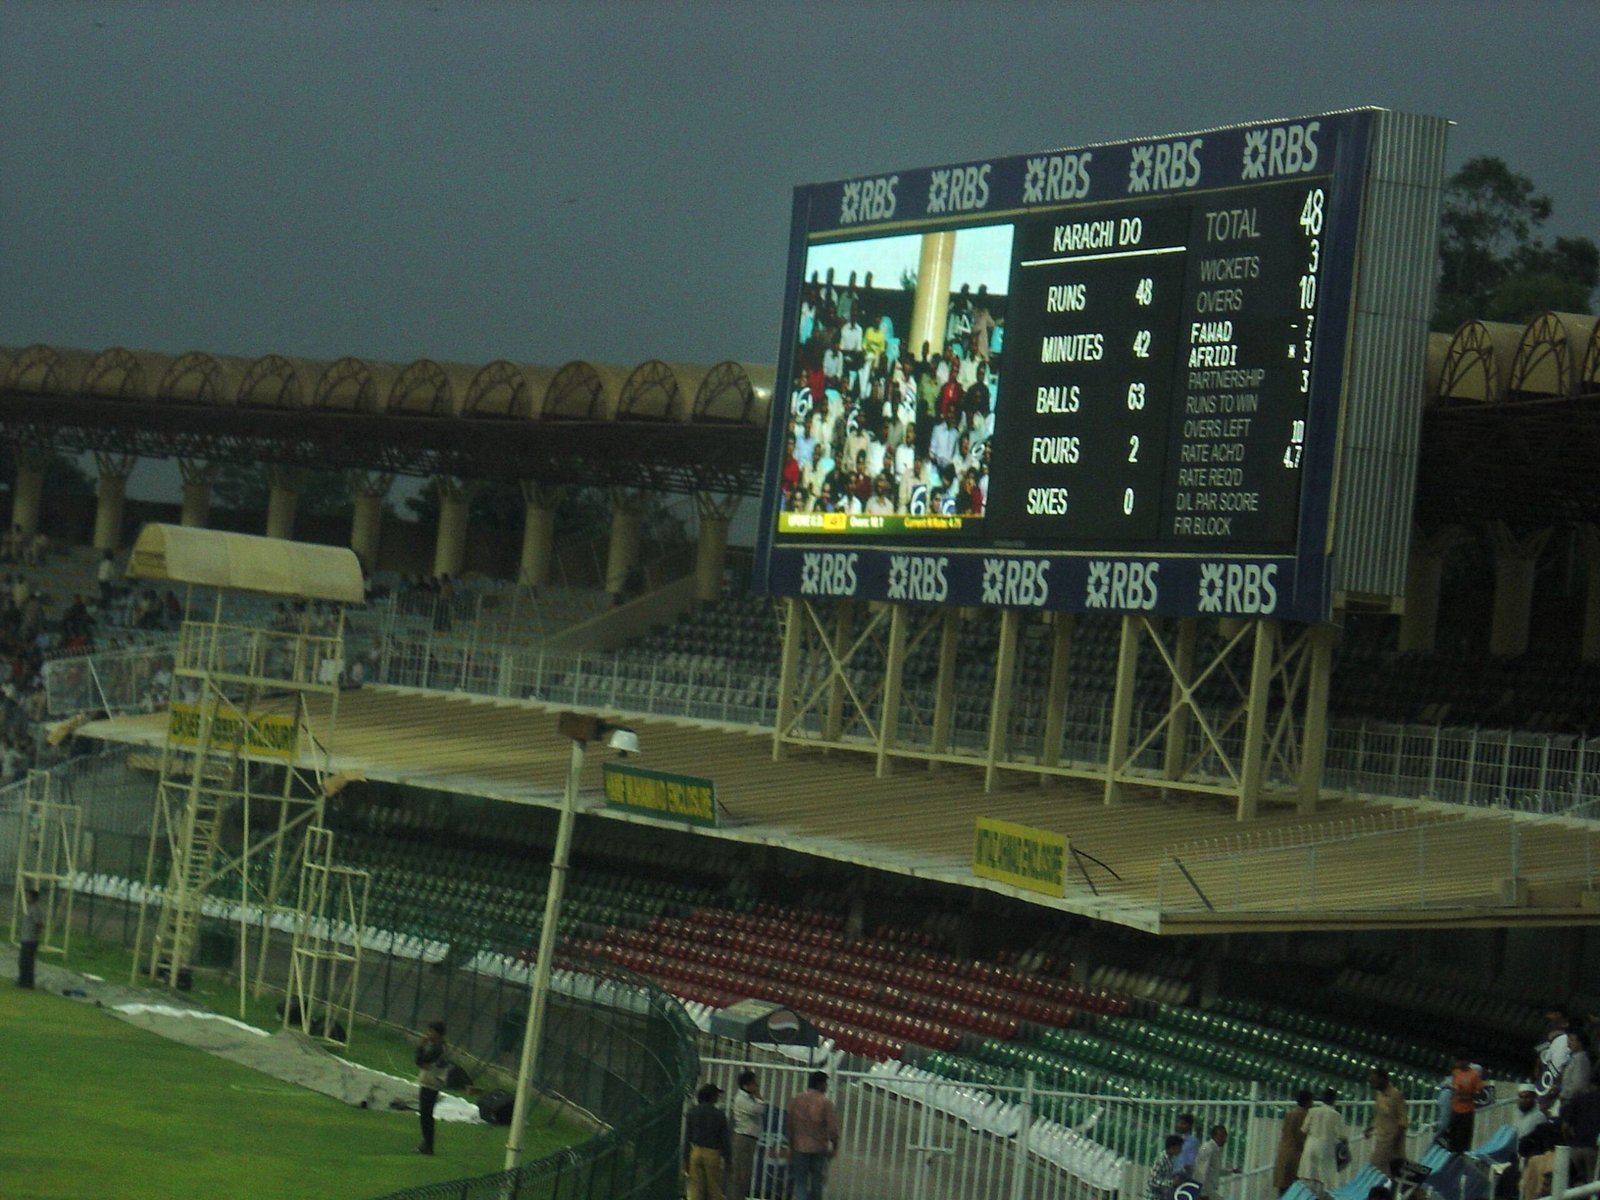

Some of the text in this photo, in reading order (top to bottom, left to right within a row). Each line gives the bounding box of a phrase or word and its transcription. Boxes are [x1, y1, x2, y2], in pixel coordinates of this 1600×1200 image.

[1268, 121, 1320, 176] RBS
[1046, 153, 1092, 201] RBS
[1153, 138, 1203, 190] RBS
[859, 175, 899, 221] RBS
[949, 163, 991, 211] RBS
[1205, 208, 1261, 241] TOTAL
[1300, 188, 1324, 236] 48
[1053, 217, 1143, 252] KARACHI DO
[1200, 255, 1260, 282] WICKETS
[1308, 238, 1320, 273] 3
[1047, 283, 1086, 313] RUNS
[1135, 277, 1153, 306] 48
[1196, 288, 1243, 314] OVERS
[1299, 274, 1317, 310] 10
[1041, 333, 1104, 363] MINUTES
[1132, 330, 1151, 358] 42
[1188, 344, 1238, 368] AFRIDI
[1188, 368, 1265, 390] PARTNERSHIP
[1036, 385, 1080, 414] BALLS
[1127, 382, 1146, 411] 63
[1186, 393, 1258, 414] RUNS TO WIN
[1184, 418, 1252, 439] OVERS LEFT
[1031, 436, 1080, 464] FOURS
[1127, 434, 1140, 463] 2
[1180, 444, 1209, 463] RATE
[1178, 468, 1207, 487] RATE
[1026, 487, 1068, 515] SIXES
[1123, 487, 1135, 515] 0
[1195, 492, 1218, 511] PAR
[1219, 492, 1259, 511] SCORE
[1193, 516, 1232, 535] BLOCK
[820, 553, 858, 595] RBS
[908, 556, 949, 602] RBS
[1004, 559, 1050, 606] RBS
[1110, 562, 1159, 610] RBS
[1225, 563, 1278, 615] RBS
